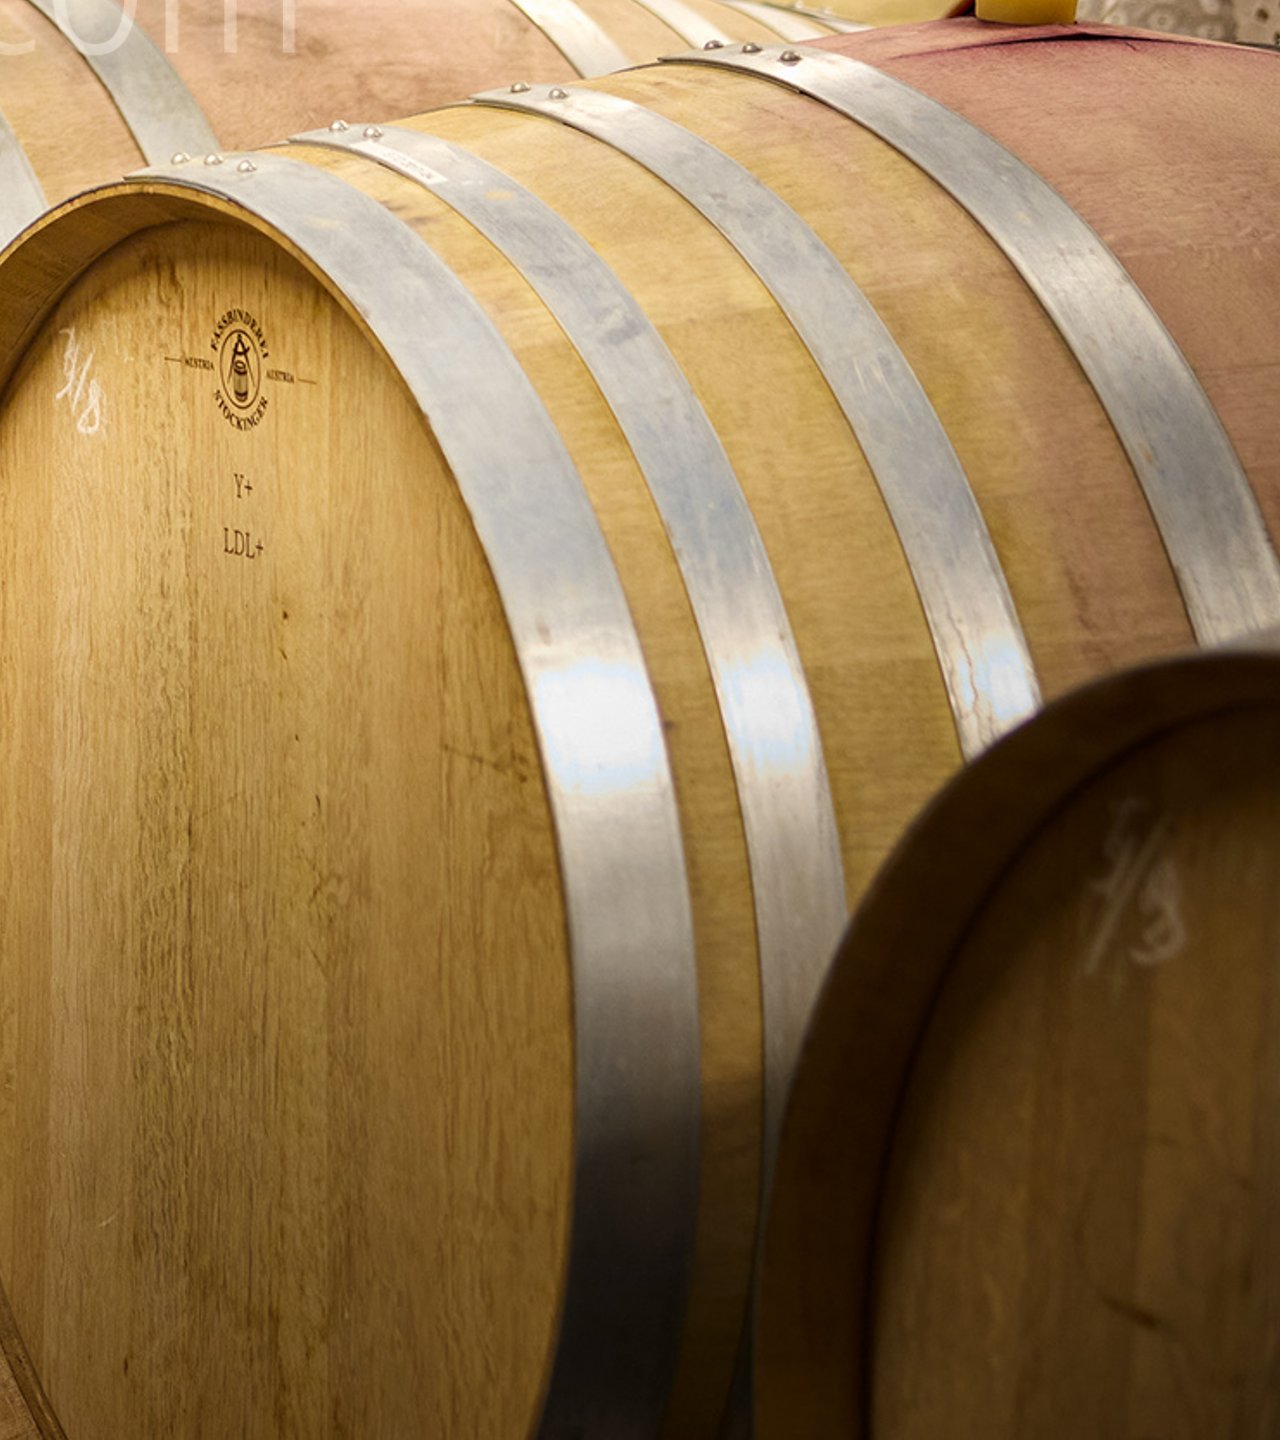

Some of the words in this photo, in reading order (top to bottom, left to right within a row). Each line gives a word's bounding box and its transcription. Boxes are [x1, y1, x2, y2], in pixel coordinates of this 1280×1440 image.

[213, 389, 269, 432] STOCKINGER
[233, 472, 253, 499] Y+
[223, 526, 265, 560] LDL+
